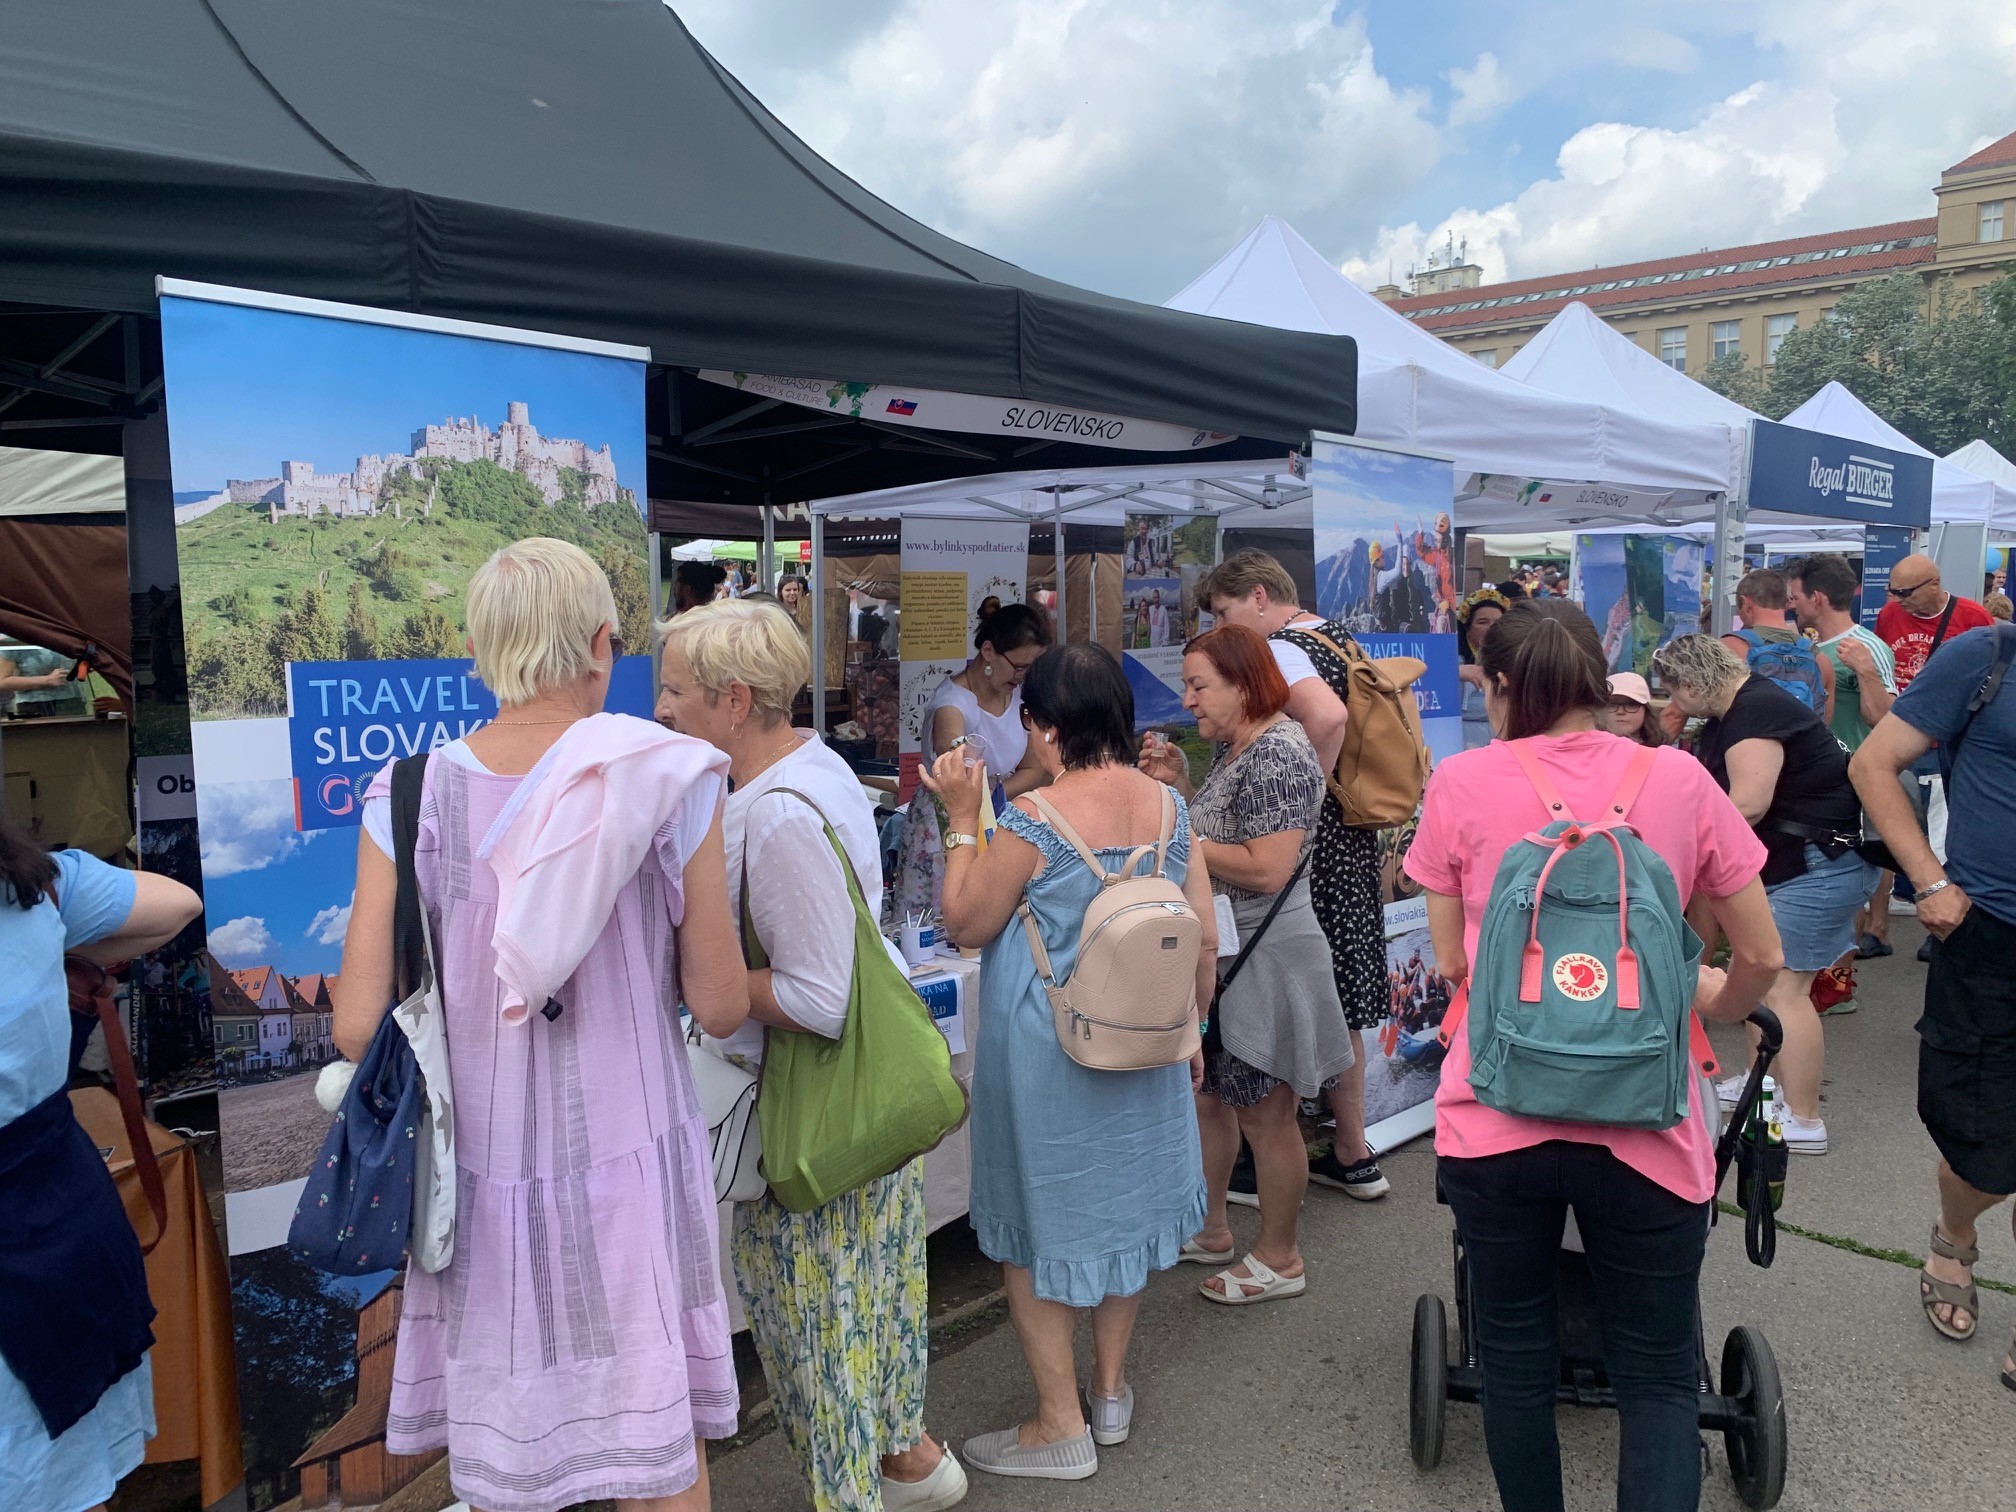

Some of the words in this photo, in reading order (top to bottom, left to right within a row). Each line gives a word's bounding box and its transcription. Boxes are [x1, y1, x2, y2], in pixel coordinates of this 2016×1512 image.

[750, 381, 776, 395] FOOD
[778, 388, 784, 396] &
[785, 390, 824, 405] CULTURE
[1001, 407, 1124, 439] SLOVENSKO
[1808, 456, 1846, 496] Regal
[1846, 464, 1893, 499] BURGER
[1576, 489, 1629, 508] SLOVENSKO
[905, 540, 1026, 555] www.bylinkyspodtatier.sk
[1411, 643, 1425, 662] IN
[308, 676, 480, 717] TRAVEL
[314, 719, 493, 765] SLOVAK
[1384, 904, 1428, 926] w.slovakia.
[934, 983, 949, 994] NA
